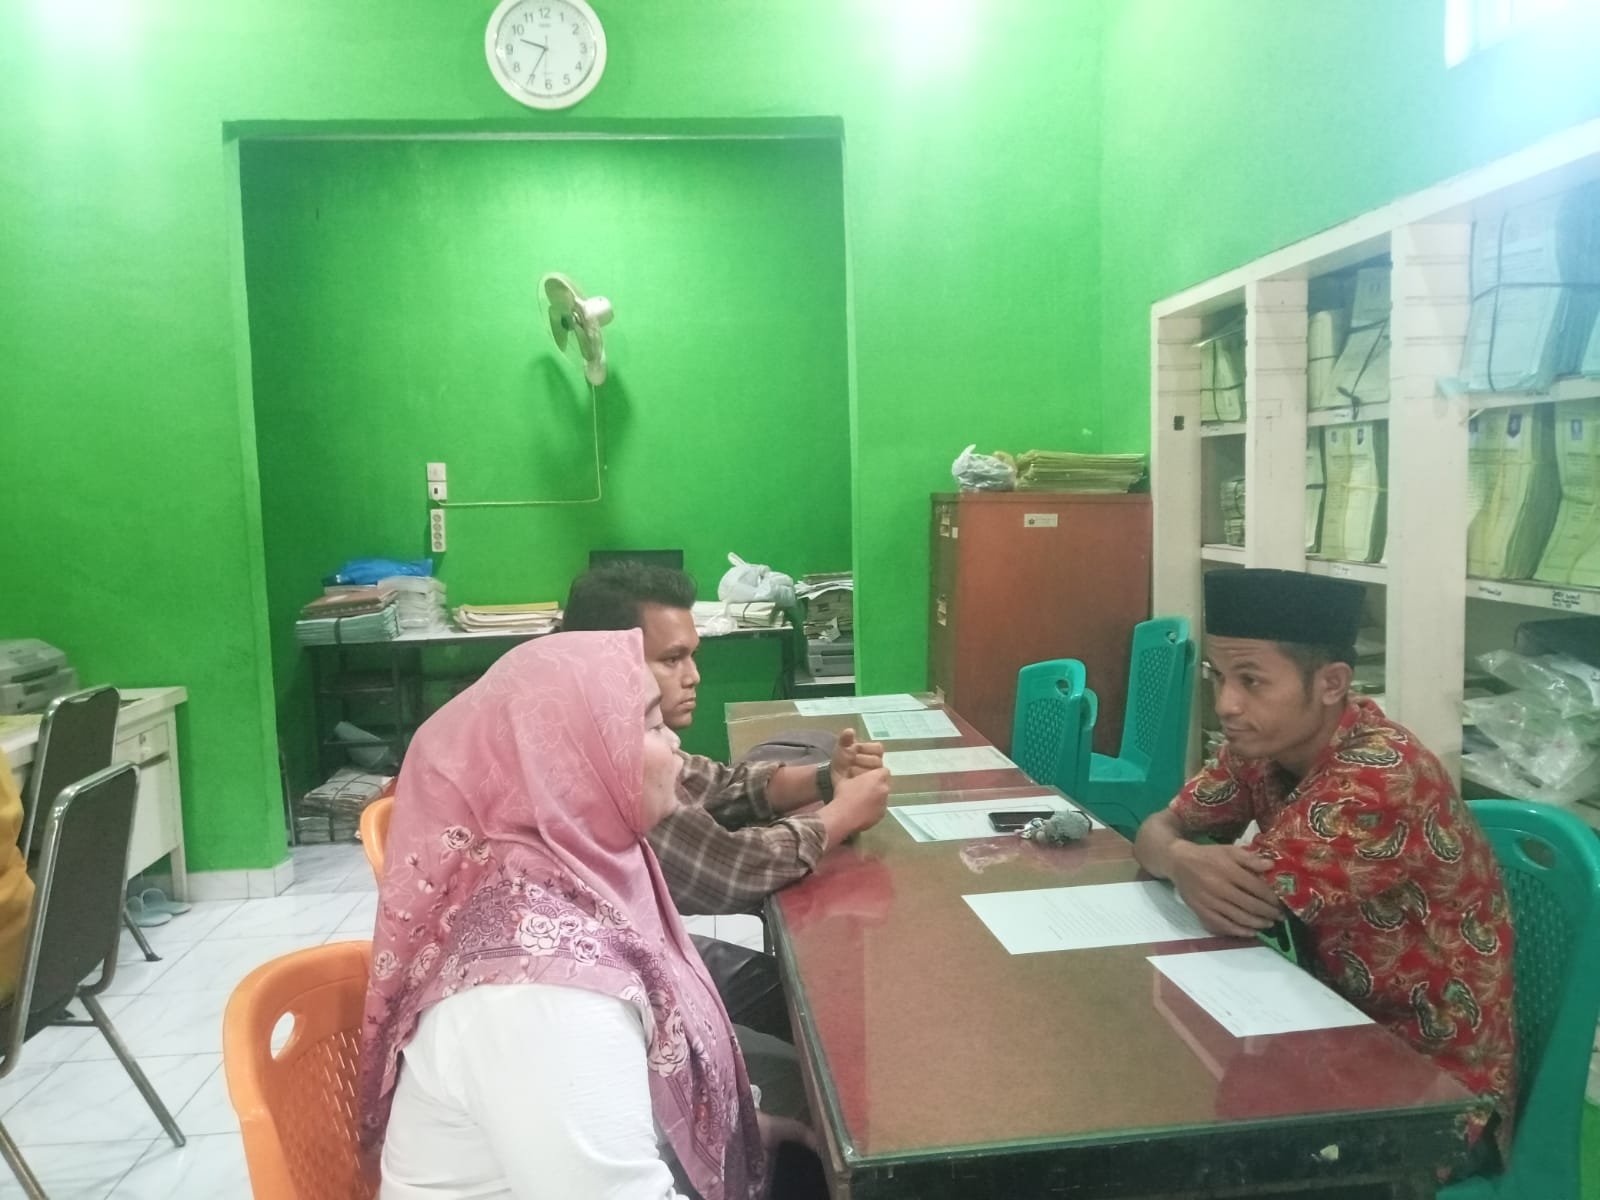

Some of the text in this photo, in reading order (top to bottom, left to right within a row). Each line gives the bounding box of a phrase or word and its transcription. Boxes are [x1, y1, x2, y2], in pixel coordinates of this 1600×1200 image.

[524, 12, 534, 23] 11
[538, 8, 550, 18] 12
[560, 12, 564, 22] 1
[512, 24, 524, 35] 10
[572, 24, 580, 35] 2
[506, 44, 514, 55] 9
[580, 42, 588, 54] 3
[514, 62, 520, 73] 8
[576, 62, 582, 71] 4
[545, 79, 552, 90] 6
[564, 74, 570, 85] 5
